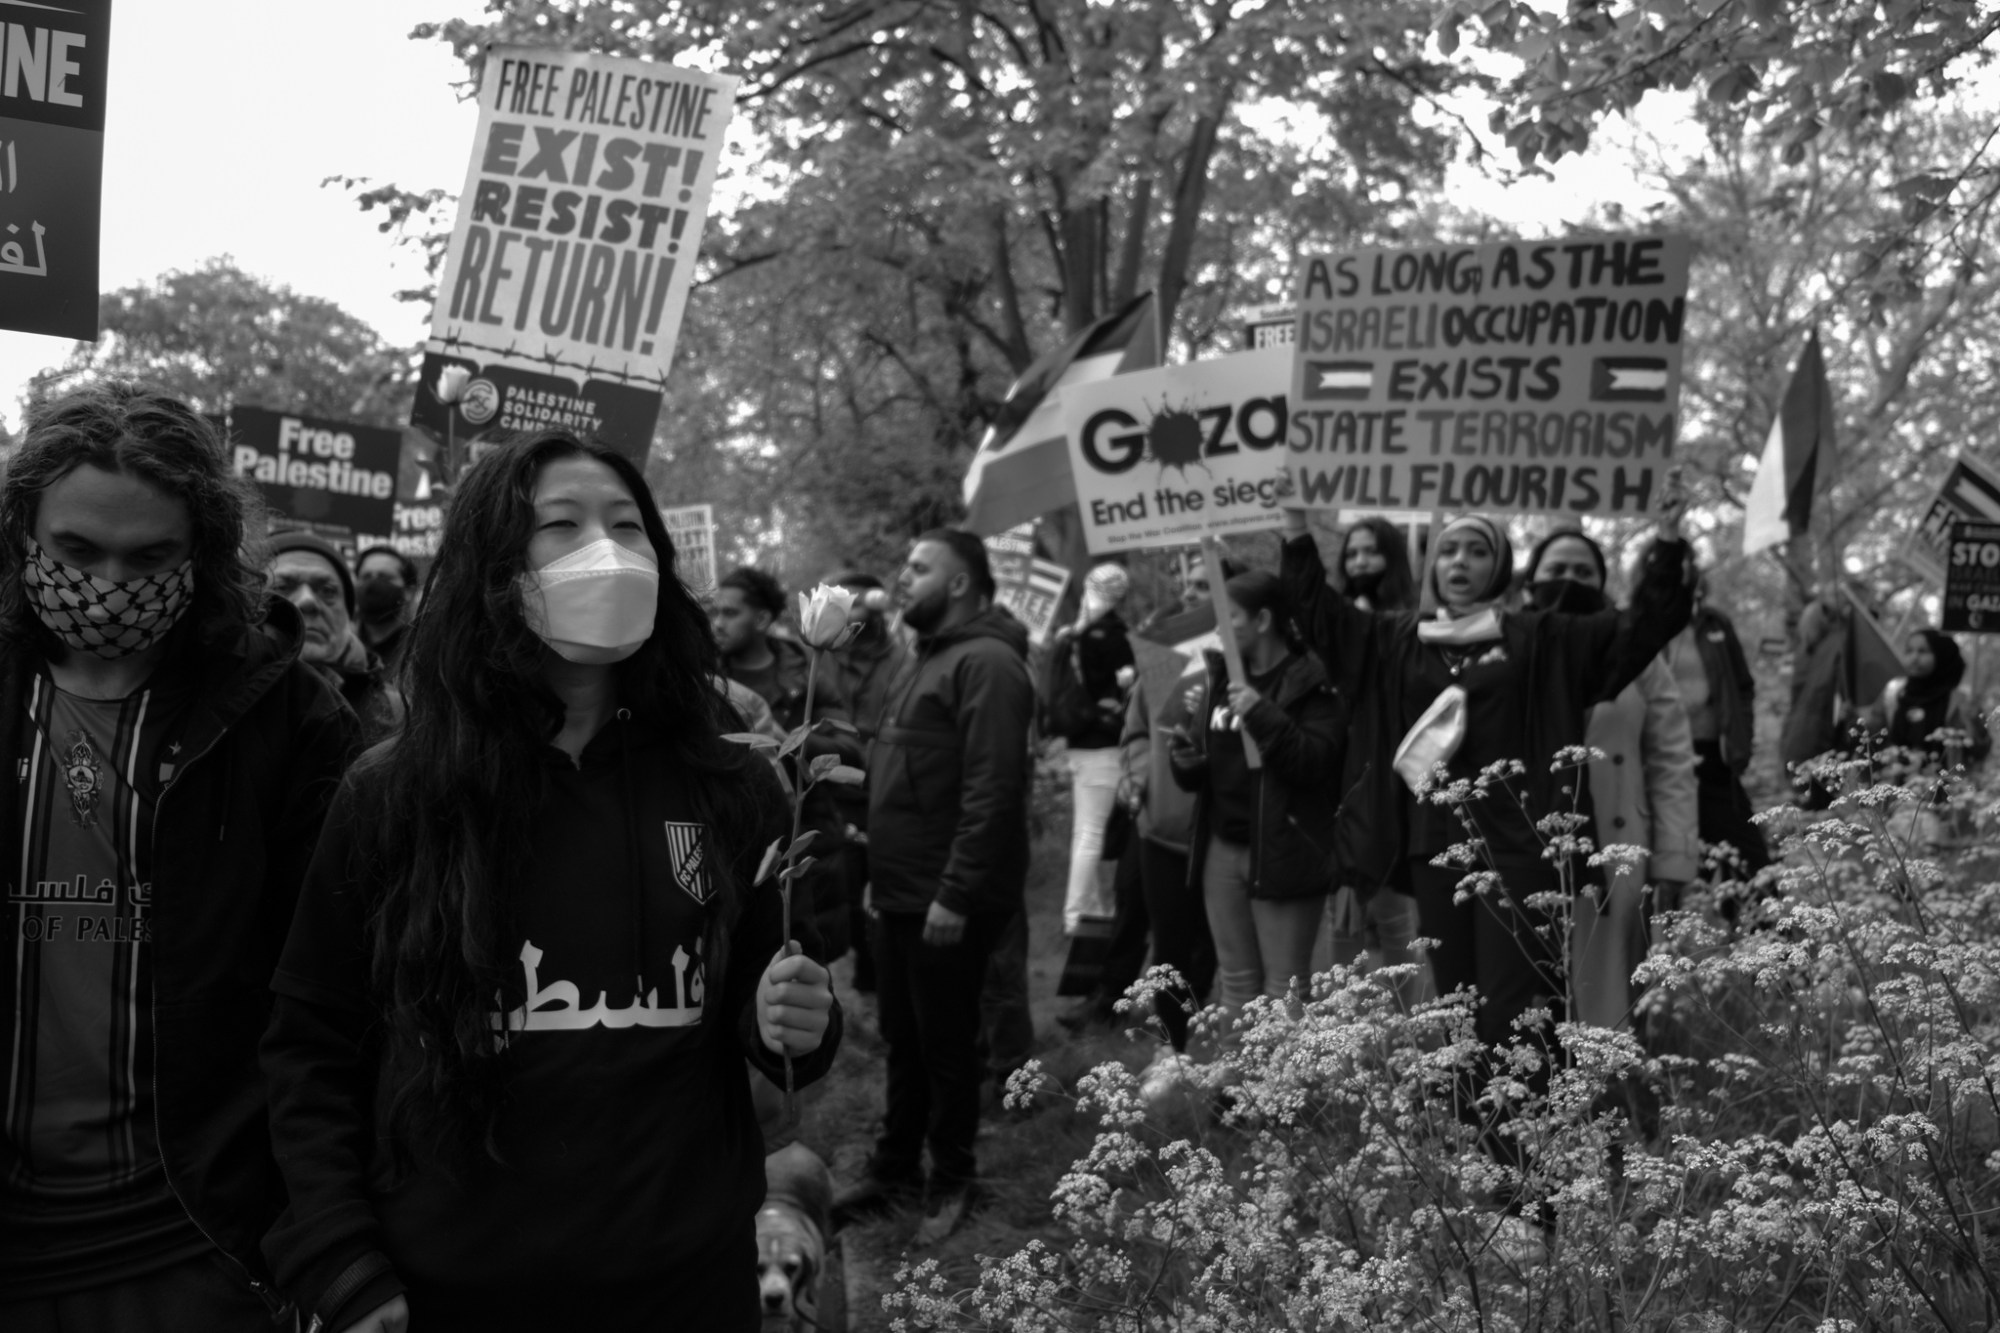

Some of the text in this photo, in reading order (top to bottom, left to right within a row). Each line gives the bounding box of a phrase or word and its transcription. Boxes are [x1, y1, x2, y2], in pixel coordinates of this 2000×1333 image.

[495, 58, 718, 140] FREE PALESTINE
[481, 121, 704, 203] EXIST!
[470, 179, 689, 254] RESIST!
[449, 224, 676, 355] RETURN!
[1305, 240, 1664, 298] AS LONG AS THE
[1255, 325, 1295, 350] FREE
[1300, 296, 1685, 354] ISRAELI OCCUPATION
[506, 385, 596, 415] PALESTINE
[1387, 355, 1560, 401] EXISTS
[278, 416, 356, 459] Free
[503, 401, 602, 431] SOLIDARITY
[1288, 409, 1674, 460] STATE TERRORISM
[232, 444, 393, 499] Palestine
[1299, 464, 1402, 508] WILL
[1090, 477, 1282, 526] End the sieg
[22, 915, 63, 942] OF
